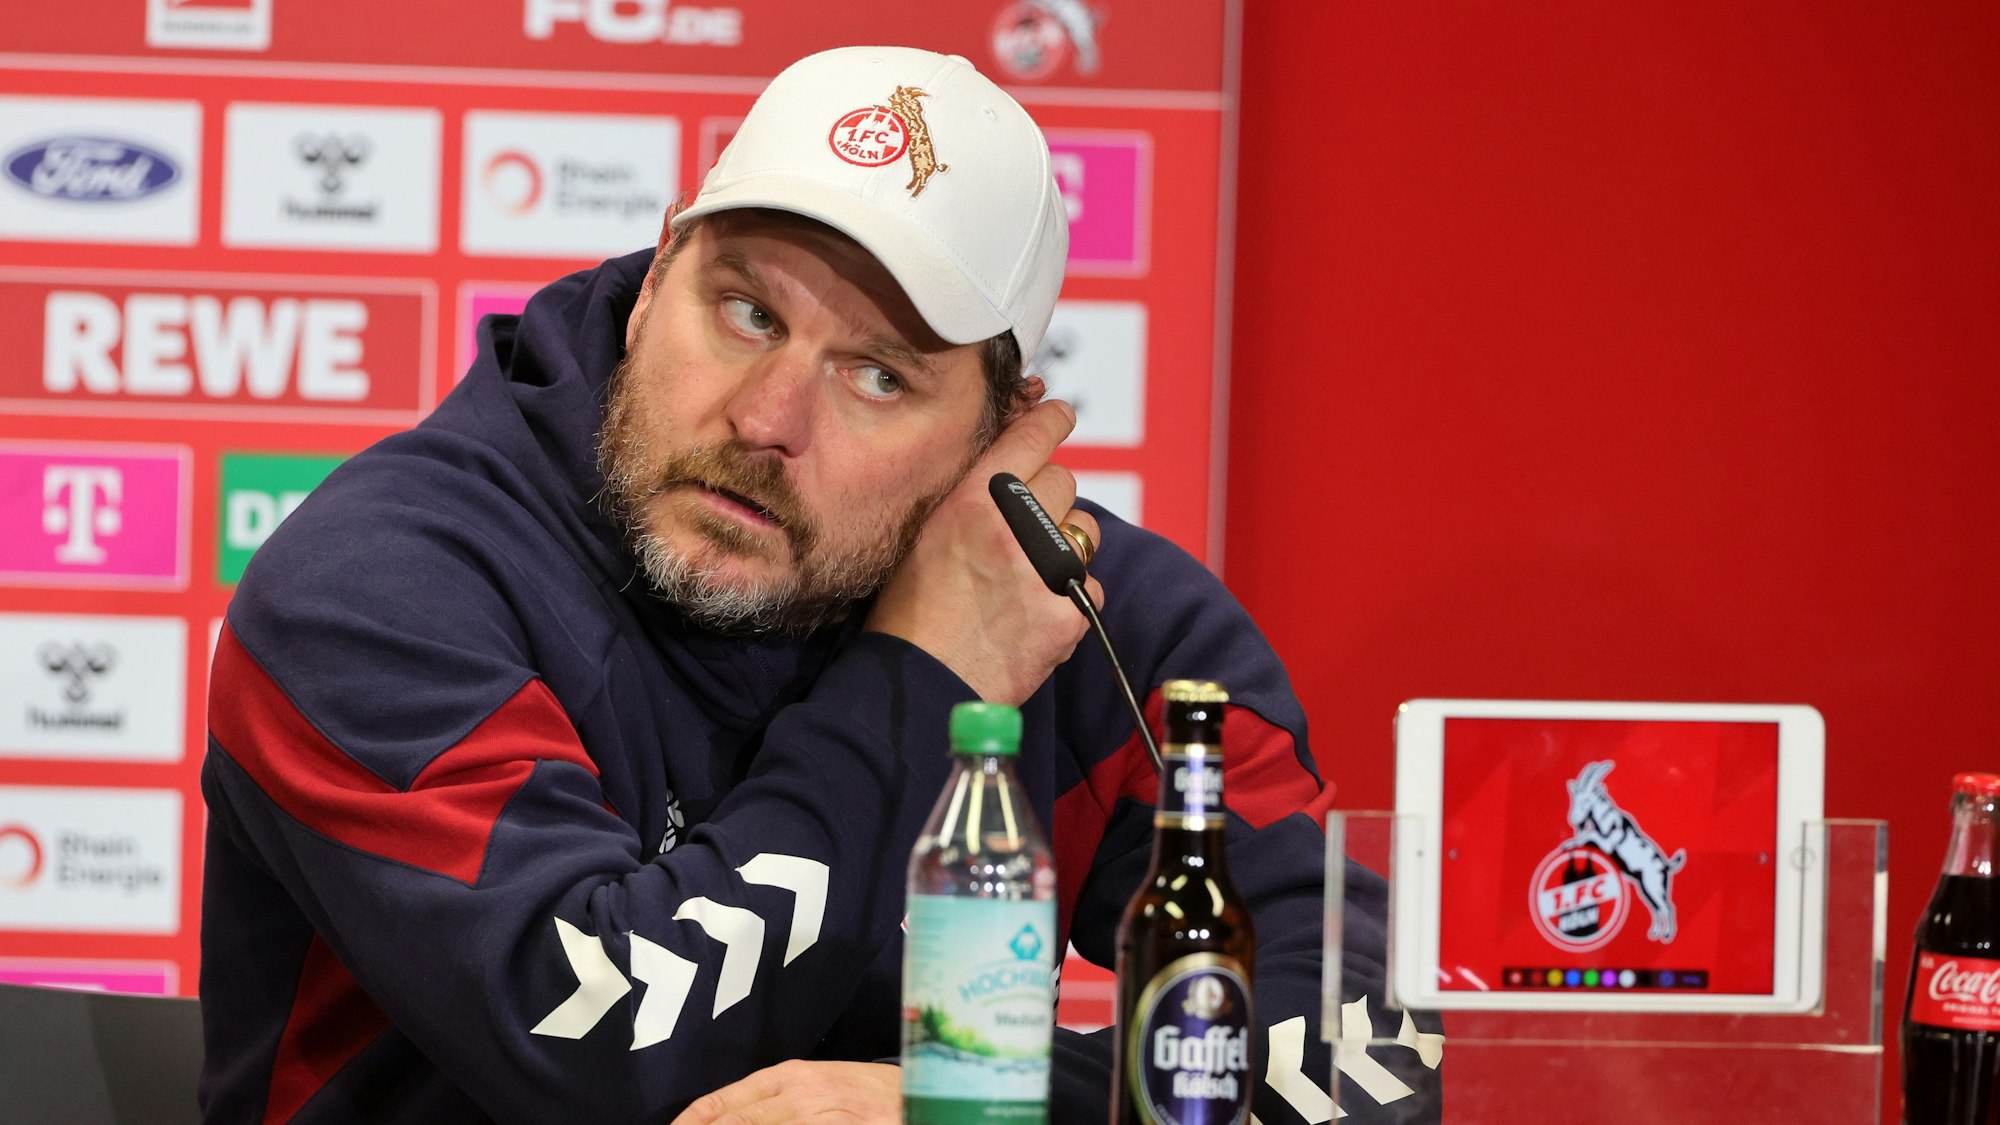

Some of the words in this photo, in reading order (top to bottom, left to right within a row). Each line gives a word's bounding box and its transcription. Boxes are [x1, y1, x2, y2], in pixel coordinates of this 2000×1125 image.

[837, 141, 879, 160] KÖLN
[847, 128, 889, 144] 1.FC
[32, 137, 152, 197] Ford
[43, 292, 369, 398] REWE
[43, 464, 123, 563] T
[1020, 494, 1070, 551] SENNHEISER
[29, 707, 124, 731] hummel
[59, 834, 133, 857] Rhein
[59, 862, 162, 890] Energie
[1554, 880, 1606, 910] 1.FC
[1153, 1024, 1248, 1073] Gaffel
